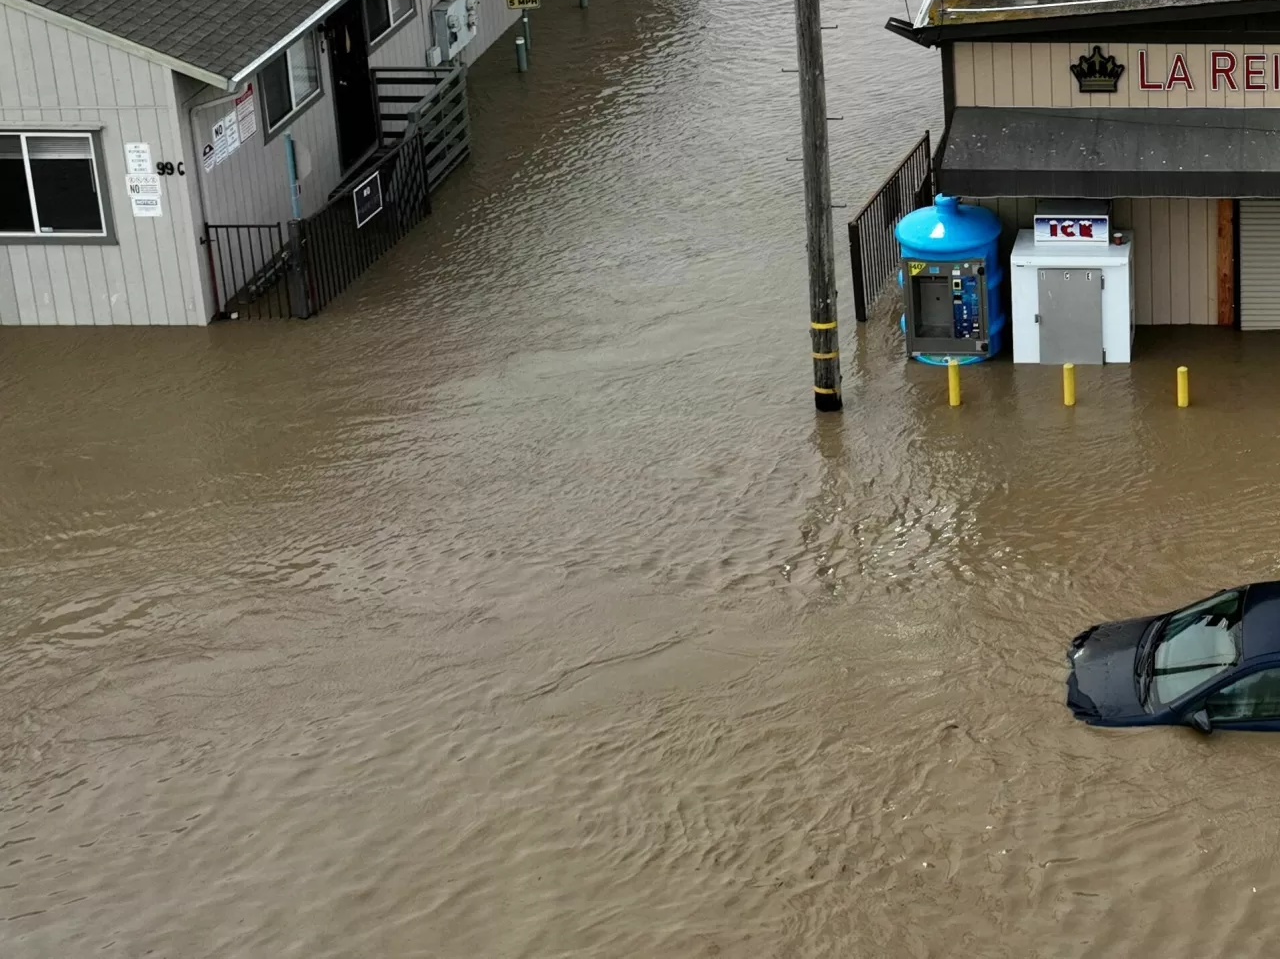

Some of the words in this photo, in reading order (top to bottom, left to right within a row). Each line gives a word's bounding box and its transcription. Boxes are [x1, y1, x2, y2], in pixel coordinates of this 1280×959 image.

[1137, 49, 1195, 92] LA
[214, 124, 223, 138] NO
[156, 162, 174, 176] 99
[130, 184, 140, 194] NO
[1049, 220, 1093, 238] ICE
